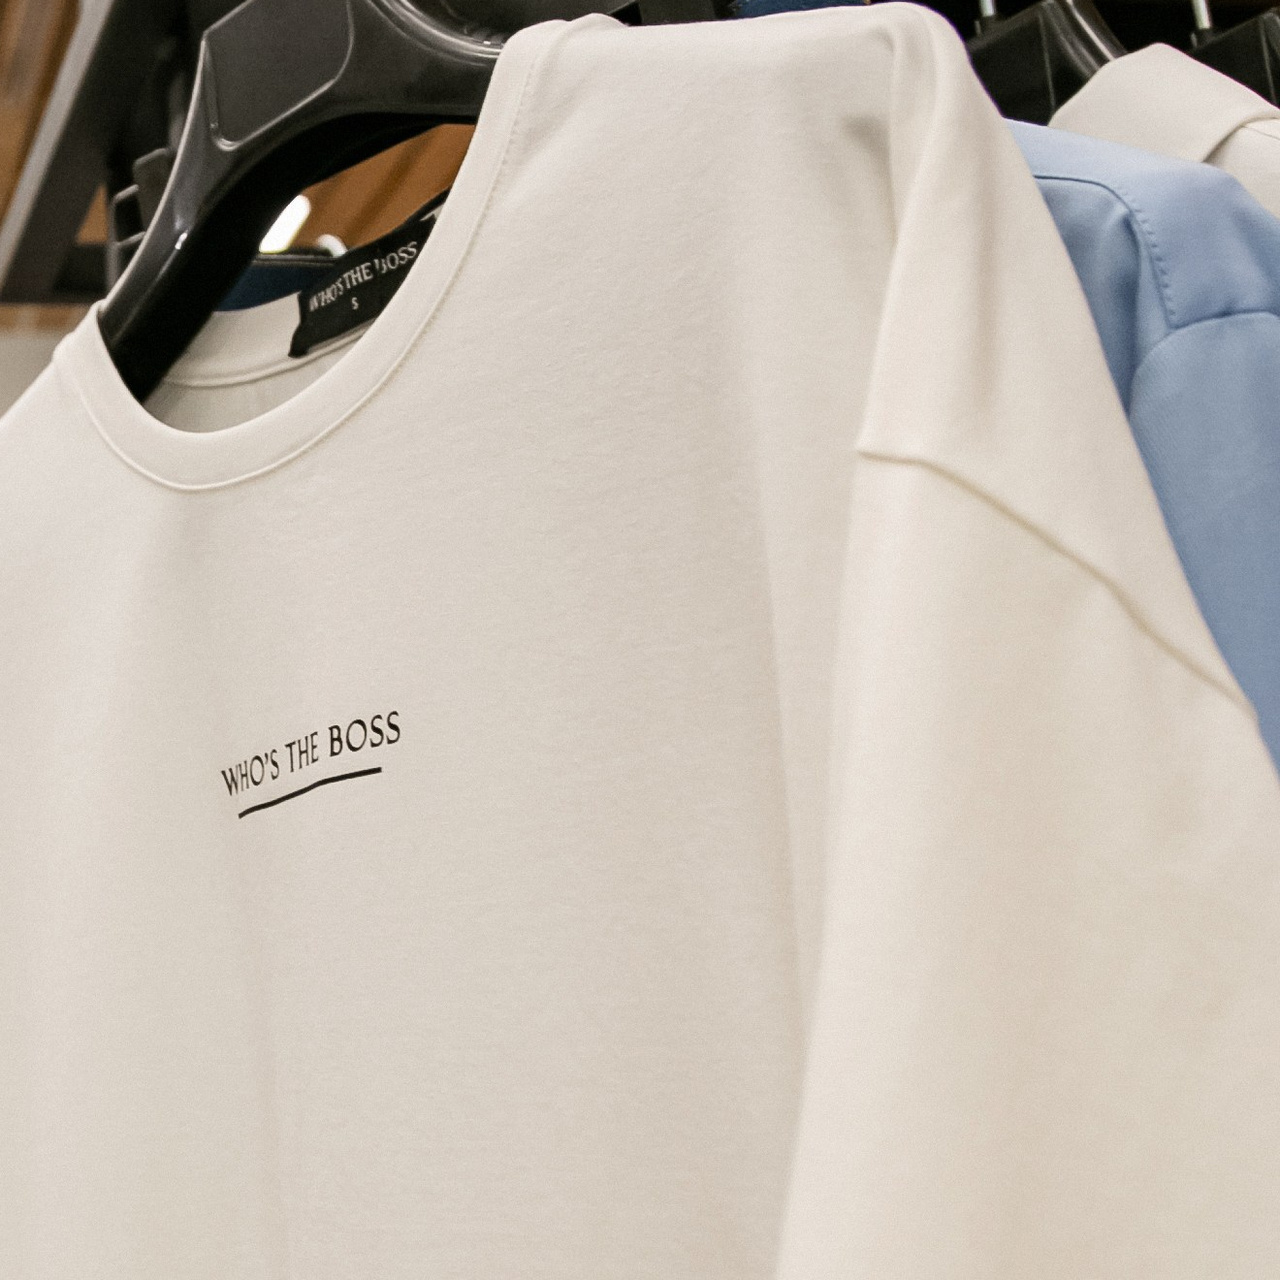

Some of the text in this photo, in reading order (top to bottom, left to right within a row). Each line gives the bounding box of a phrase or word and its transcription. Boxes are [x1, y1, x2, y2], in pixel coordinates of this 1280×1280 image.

[343, 262, 374, 289] THE
[351, 297, 359, 310] S
[220, 710, 401, 797] WHO'S THE BOSS
